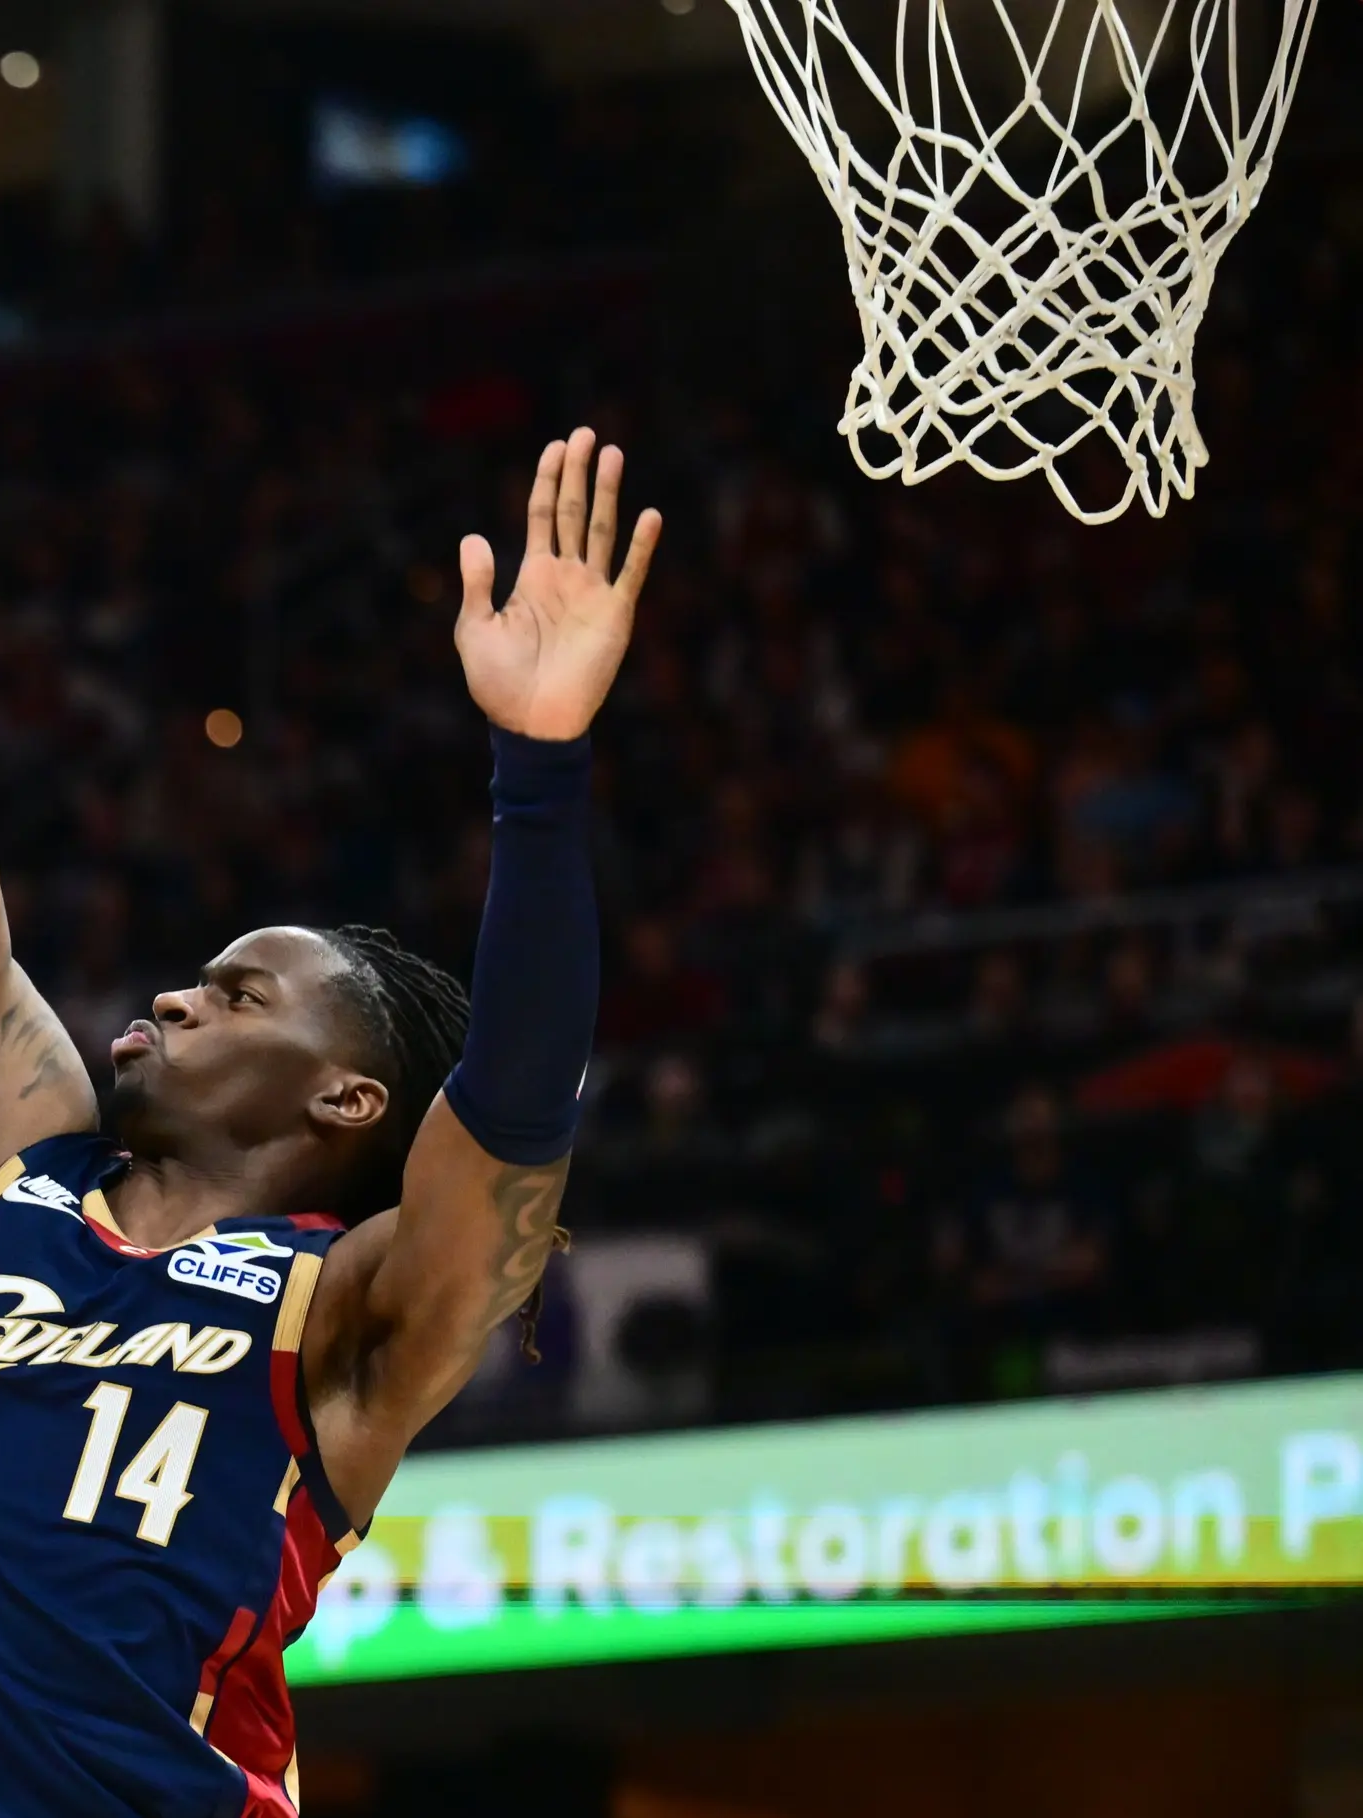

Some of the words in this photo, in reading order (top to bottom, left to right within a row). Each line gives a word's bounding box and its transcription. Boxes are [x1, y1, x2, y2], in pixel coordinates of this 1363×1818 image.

[21, 1174, 81, 1205] NIKE
[174, 1257, 277, 1296] CLIFFS
[63, 1381, 210, 1548] 14
[531, 1450, 1244, 1625] Restoration
